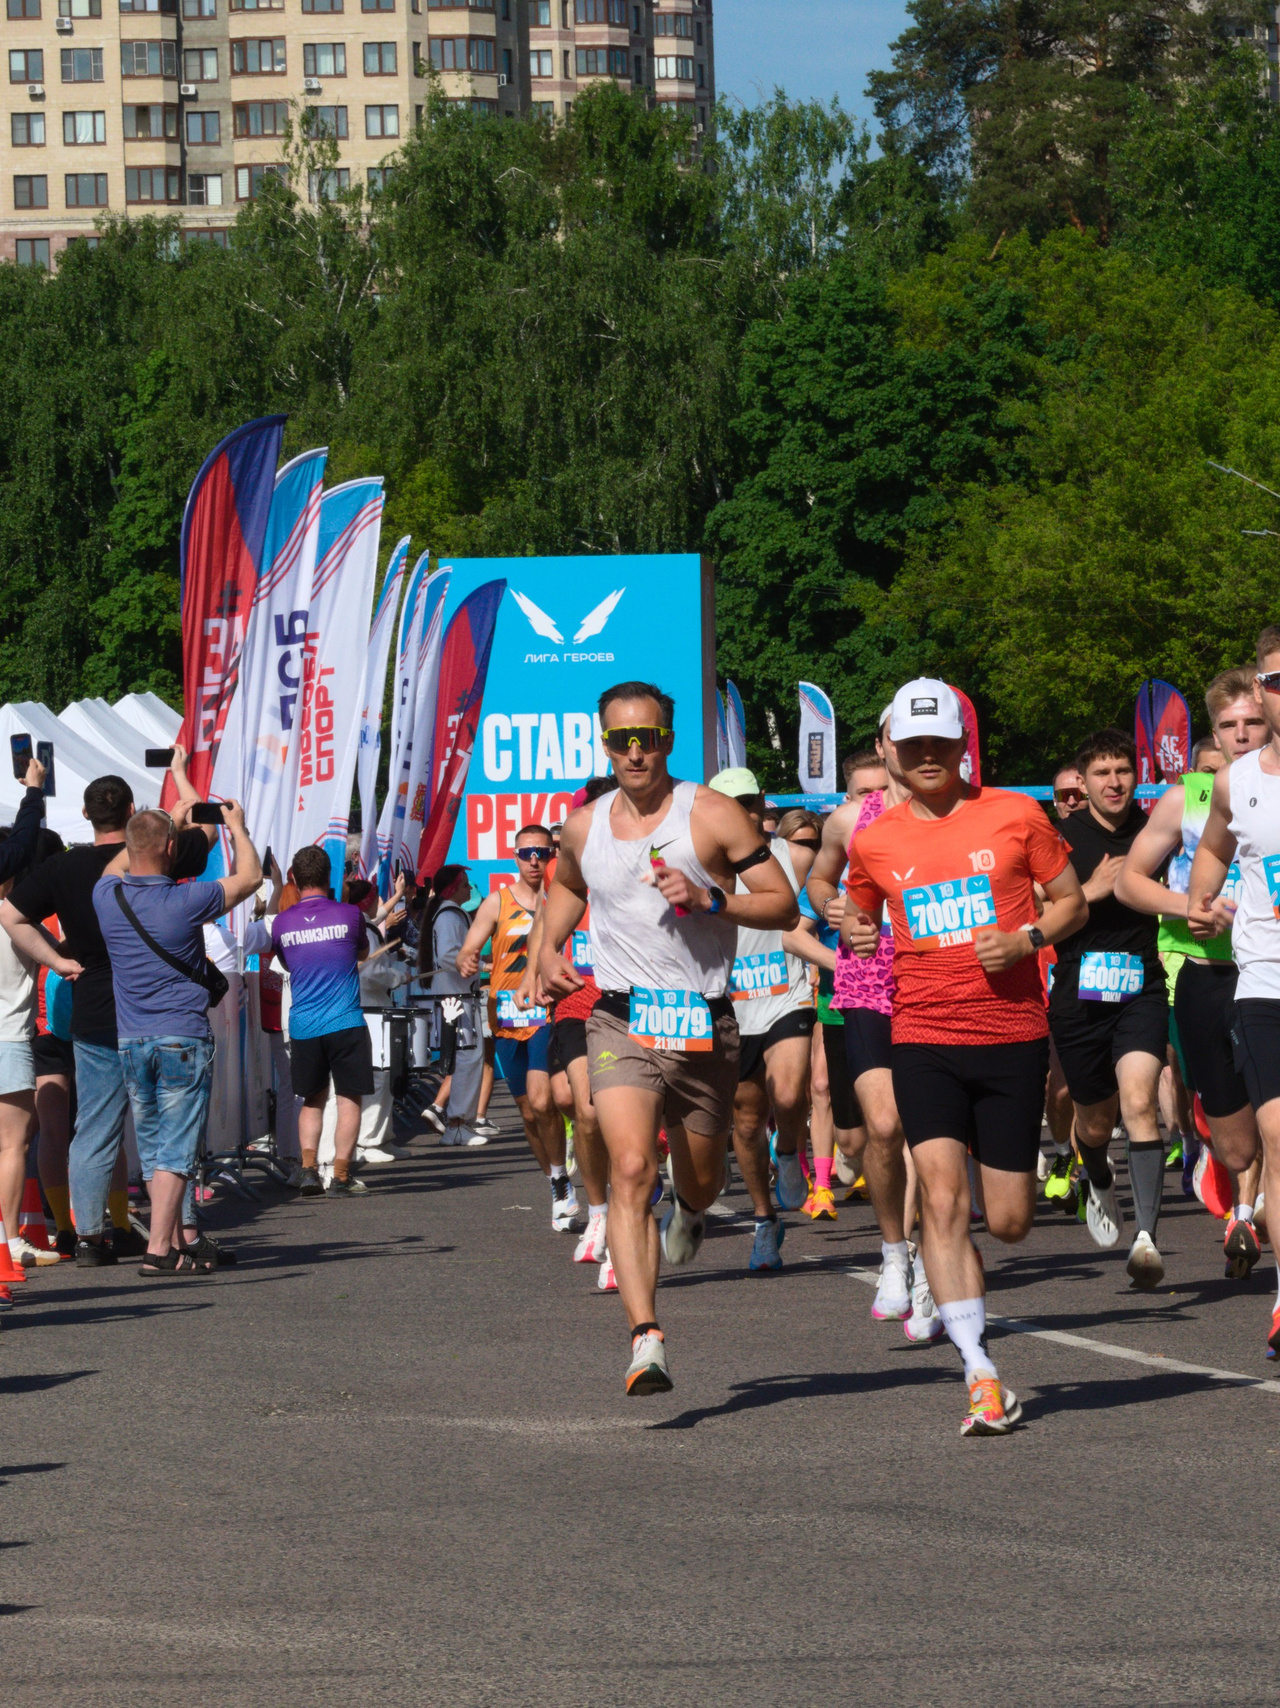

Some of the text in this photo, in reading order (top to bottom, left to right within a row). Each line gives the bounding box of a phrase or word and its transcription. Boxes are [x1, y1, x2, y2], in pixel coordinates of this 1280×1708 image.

[524, 652, 615, 663] ЛИГА ГЕРОЕВ
[315, 664, 335, 782] СПОРТ
[483, 712, 615, 782] СТАВИ
[968, 849, 996, 872] 10
[911, 892, 990, 936] 70075
[280, 924, 349, 948] ОРГАНИЗАТОР
[938, 928, 973, 948] 21.1KM
[731, 962, 782, 991] 70170
[1083, 965, 1141, 992] 50075
[634, 1003, 707, 1037] 70079
[653, 1036, 686, 1051] 21.1KM
